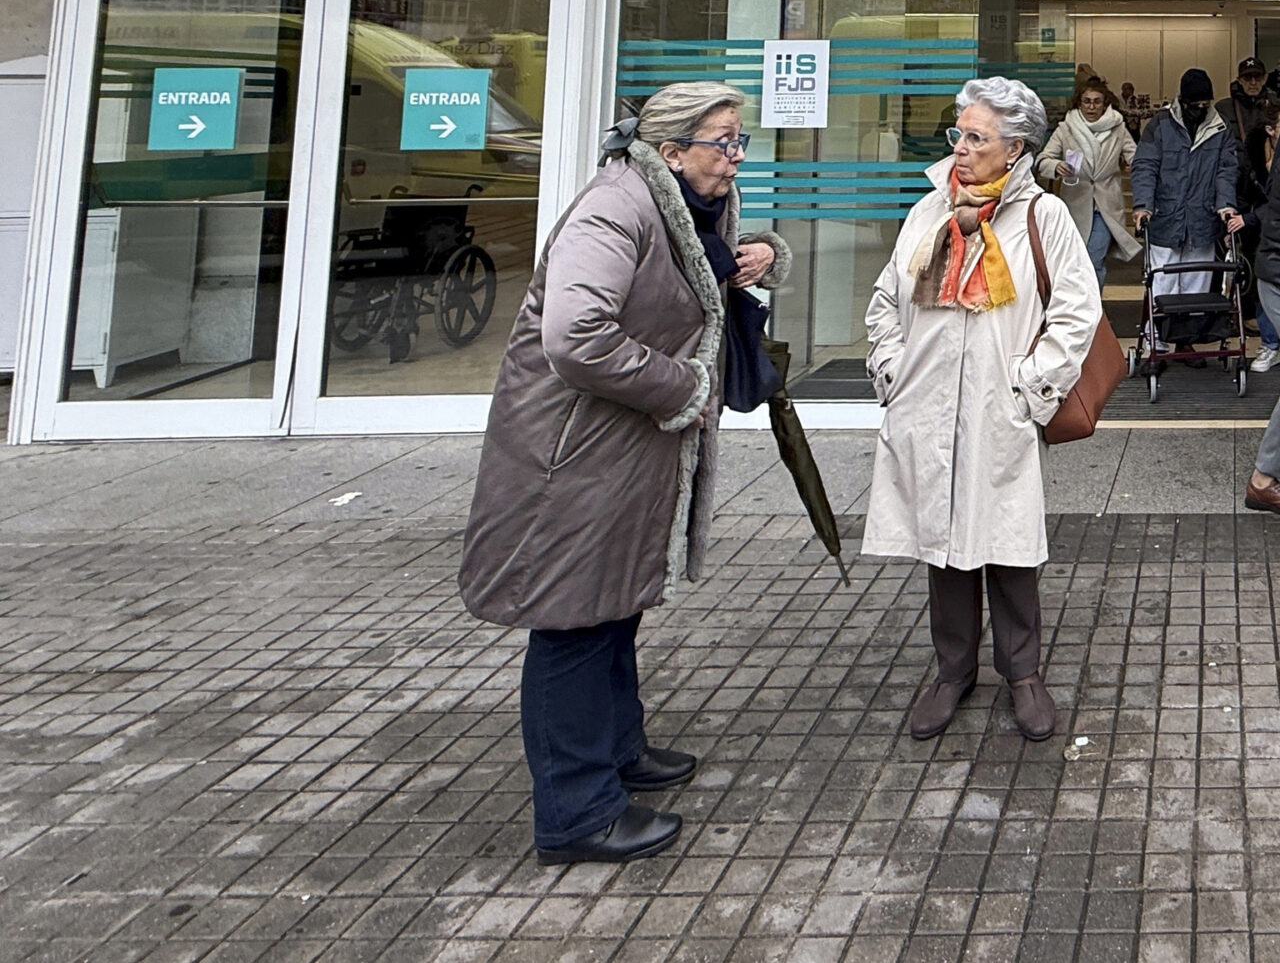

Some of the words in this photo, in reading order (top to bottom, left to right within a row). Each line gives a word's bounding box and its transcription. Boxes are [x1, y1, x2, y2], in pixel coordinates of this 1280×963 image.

[775, 77, 816, 92] FJD
[157, 91, 231, 106] ENTRADA
[409, 92, 481, 106] ENTRADA
